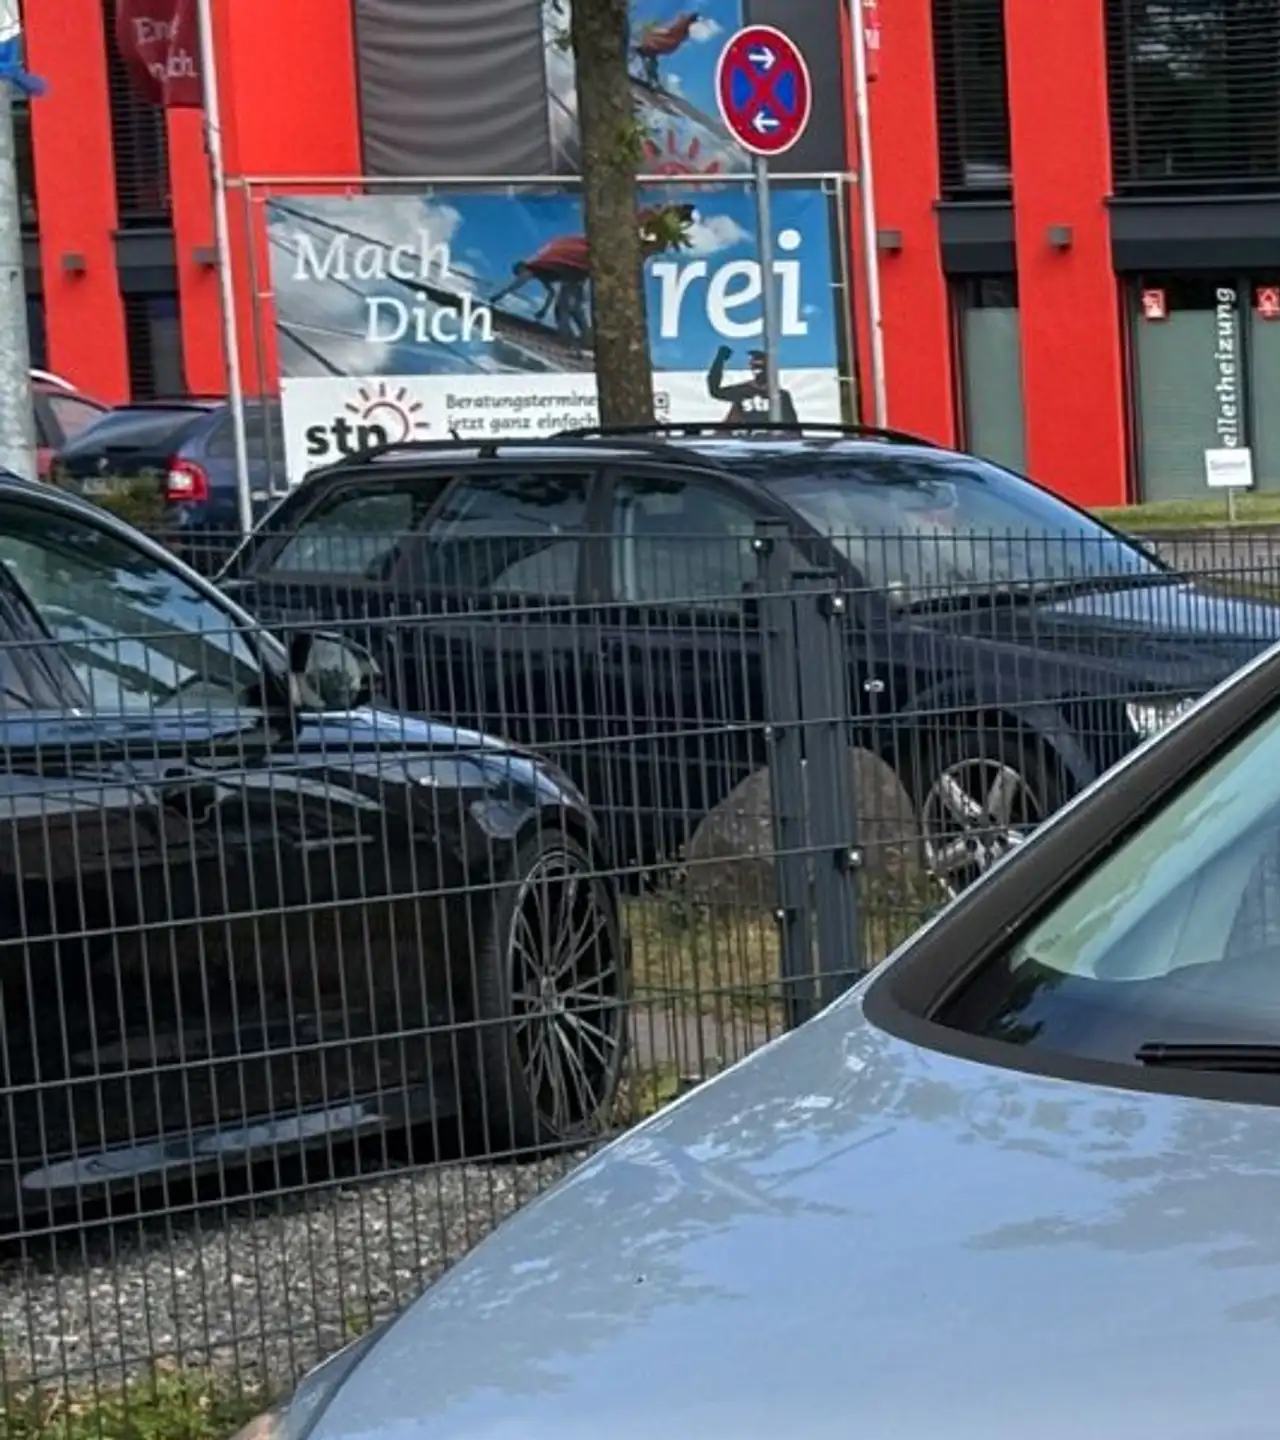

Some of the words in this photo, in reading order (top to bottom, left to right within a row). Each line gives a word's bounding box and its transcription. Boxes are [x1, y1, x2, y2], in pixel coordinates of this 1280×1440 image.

[291, 228, 455, 281] Mach
[651, 229, 808, 338] rei
[364, 291, 495, 343] Dich
[1214, 287, 1238, 448] elletheizung
